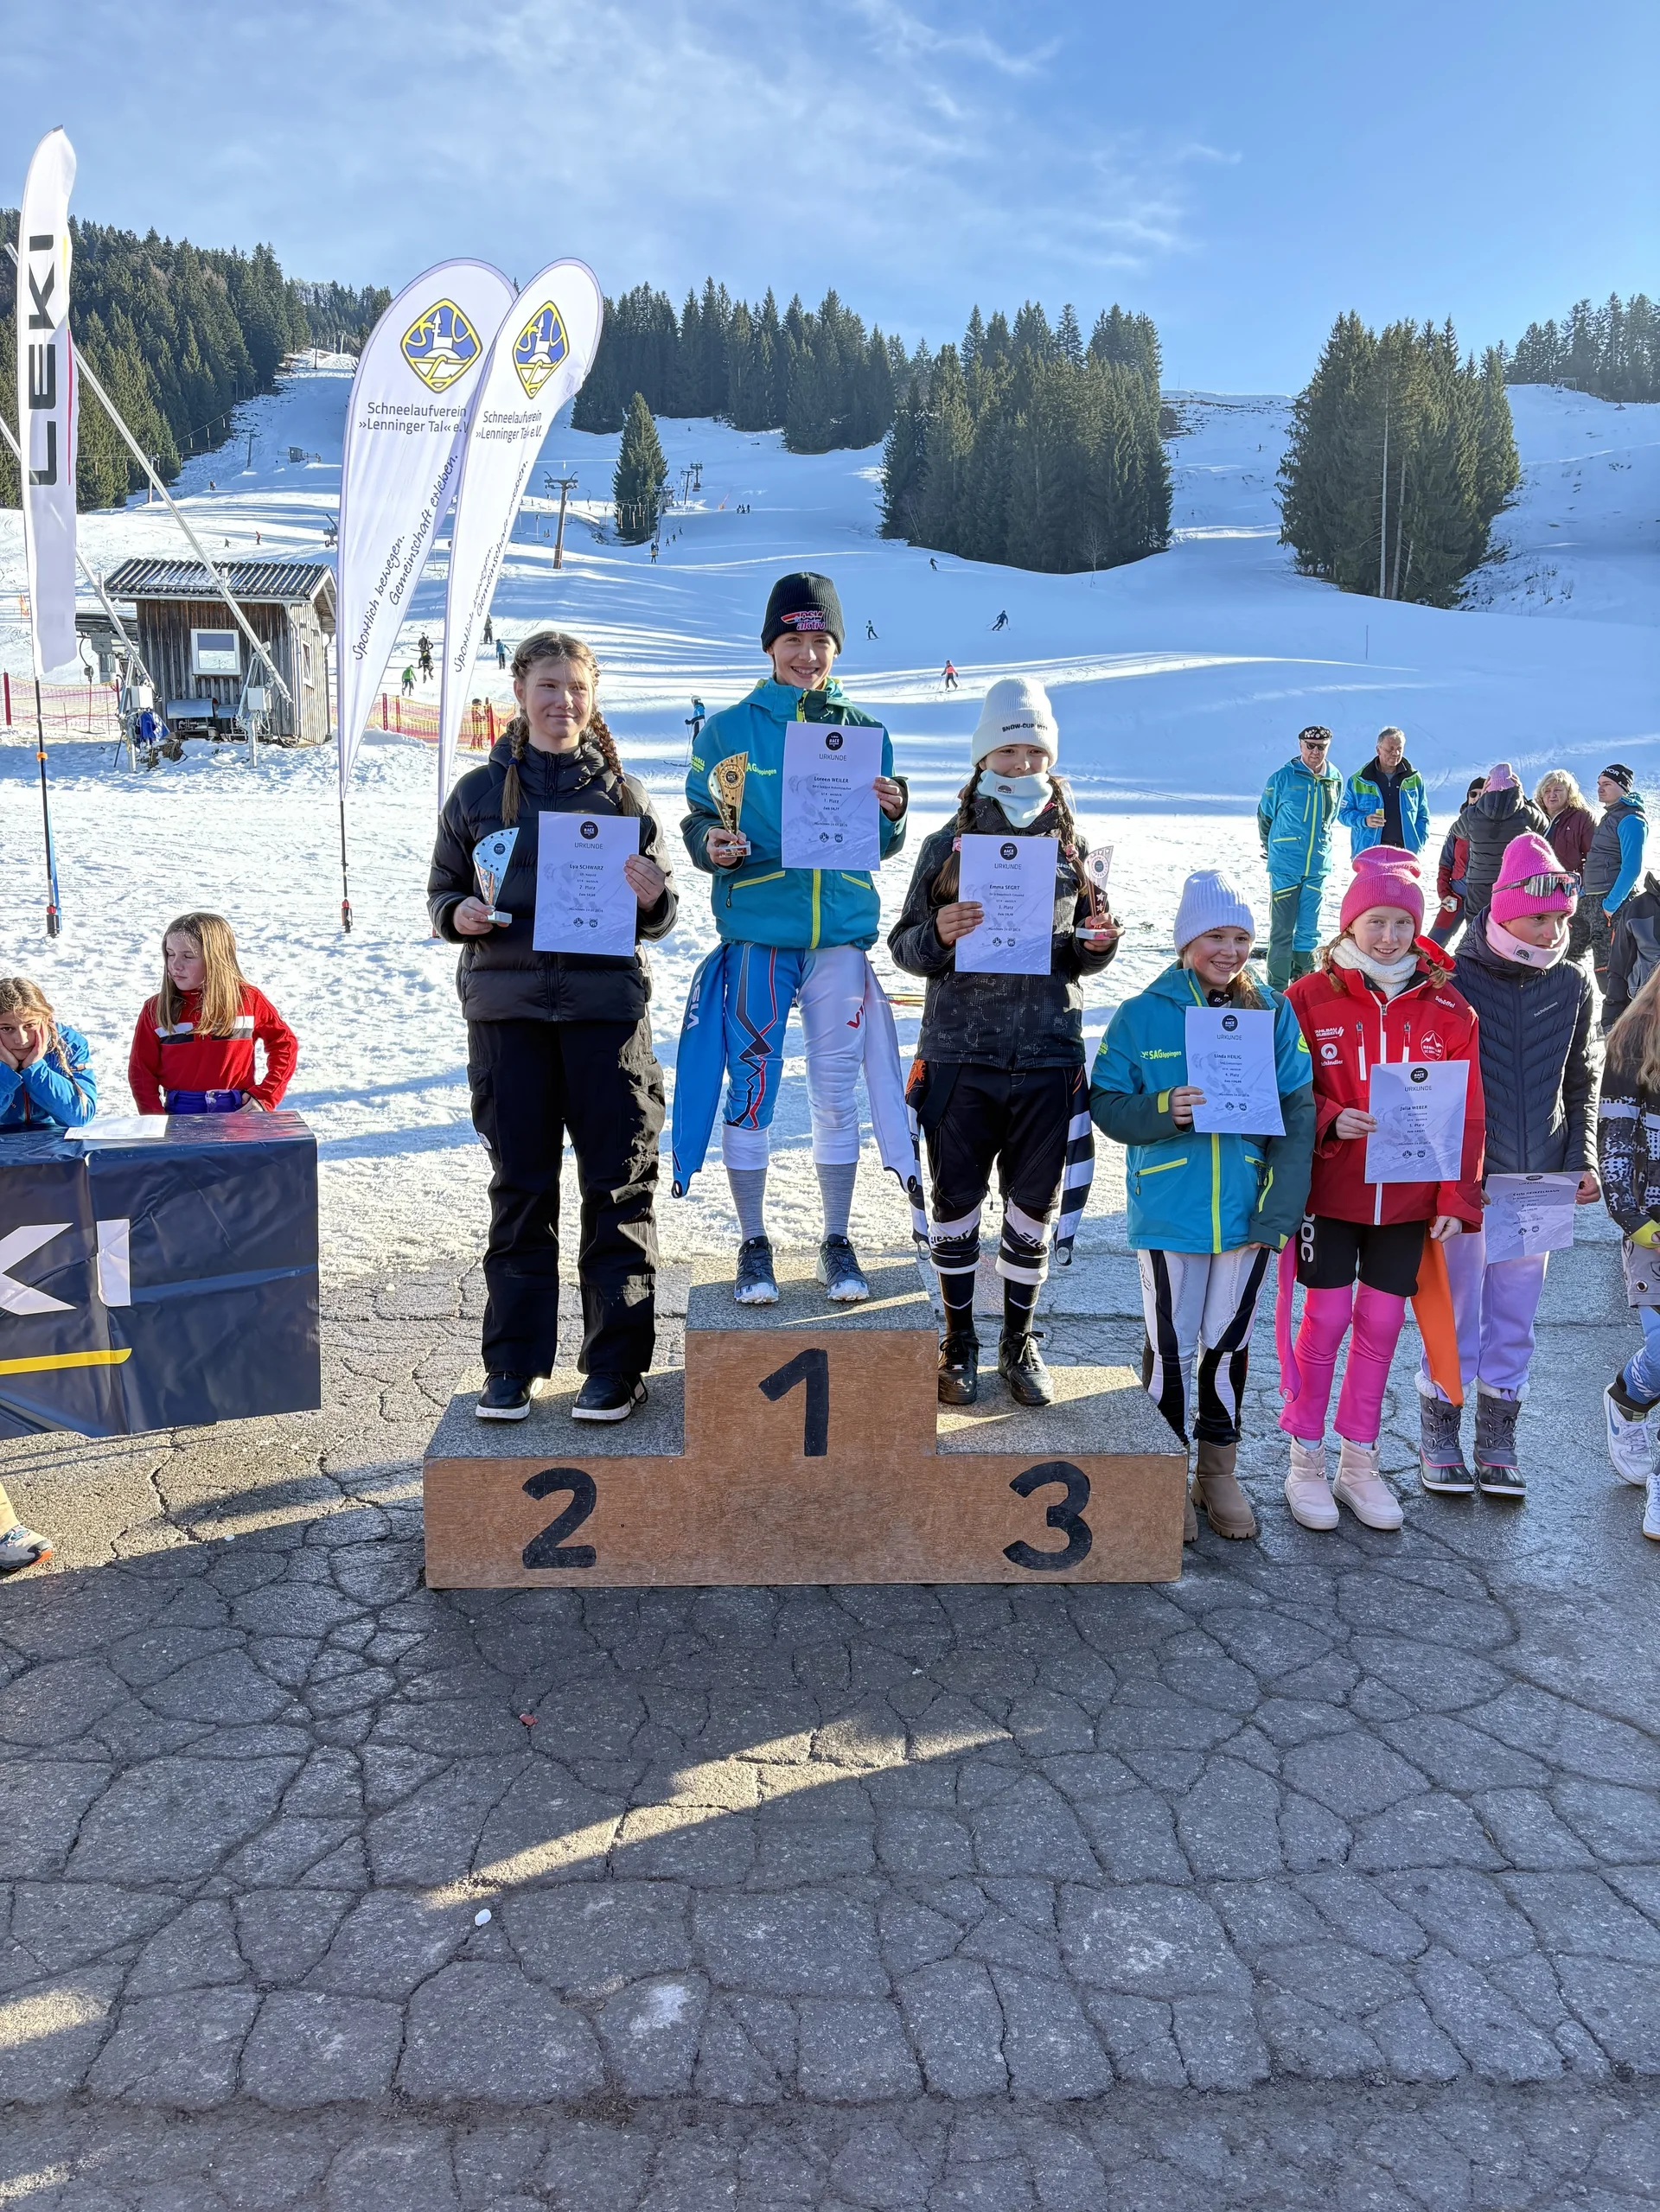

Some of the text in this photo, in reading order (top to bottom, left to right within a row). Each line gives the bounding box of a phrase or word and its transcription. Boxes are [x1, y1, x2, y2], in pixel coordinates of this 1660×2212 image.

[28, 234, 57, 487] LEKI
[367, 401, 468, 418] Schneelaufverein
[482, 409, 542, 424] Schneelaufverein
[358, 418, 425, 435] »Lenninger
[388, 455, 458, 607] Gemeinschaft erleben.
[351, 534, 406, 660] Sportlich bewegen.
[796, 620, 826, 631] aktiv
[1001, 722, 1035, 733] SNOW-CUP
[819, 753, 847, 762] URKUNDE
[1434, 995, 1456, 1009] Schöffel
[758, 1348, 829, 1457] 1
[521, 1467, 597, 1569] 2
[1002, 1461, 1093, 1571] 3
